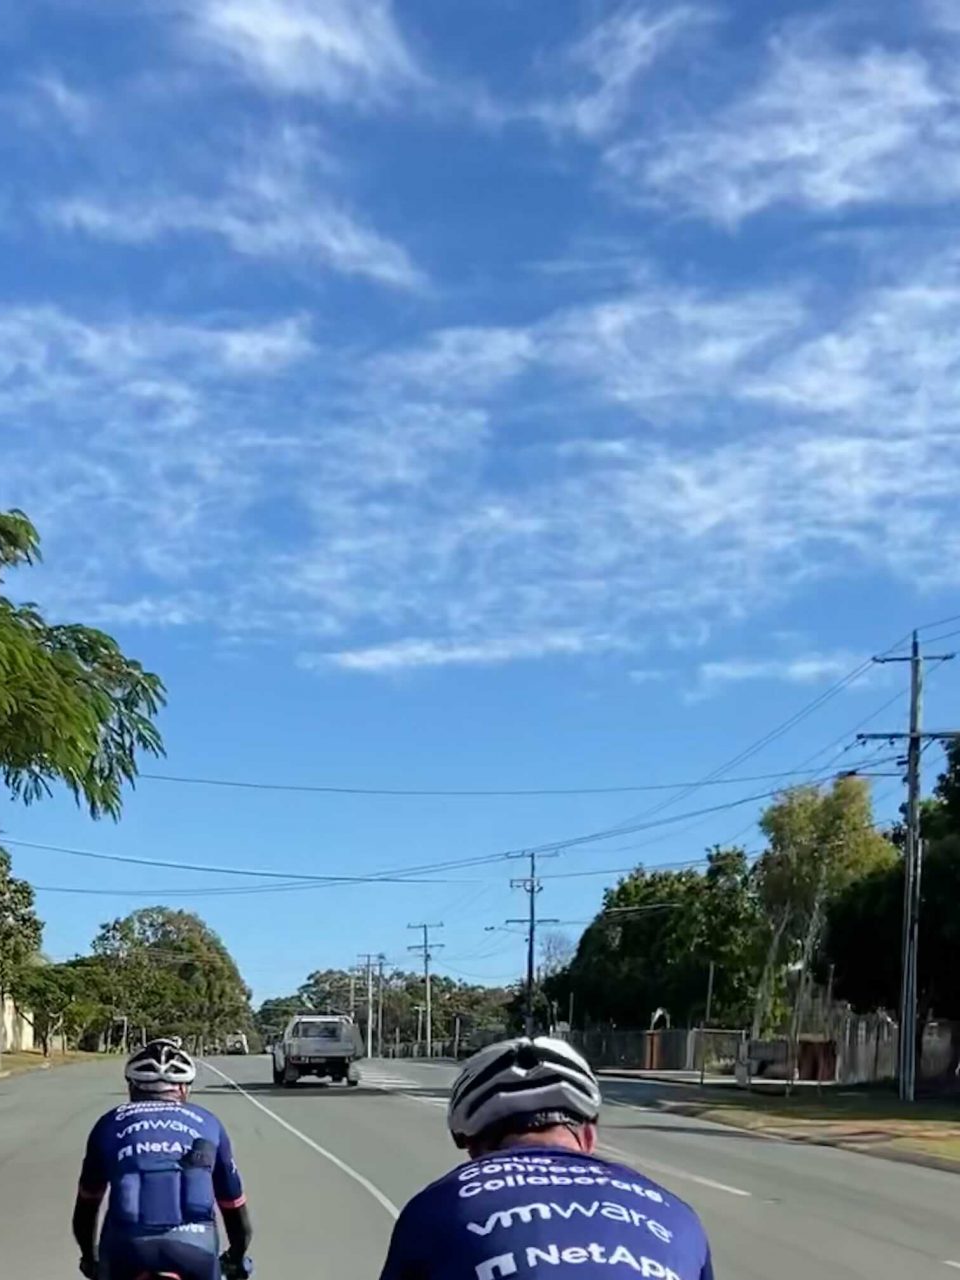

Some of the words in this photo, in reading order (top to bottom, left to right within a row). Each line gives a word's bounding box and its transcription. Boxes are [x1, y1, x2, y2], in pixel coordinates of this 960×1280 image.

[116, 1119, 202, 1139] vmware
[135, 1141, 193, 1155] NetA
[466, 1200, 674, 1244] vmware
